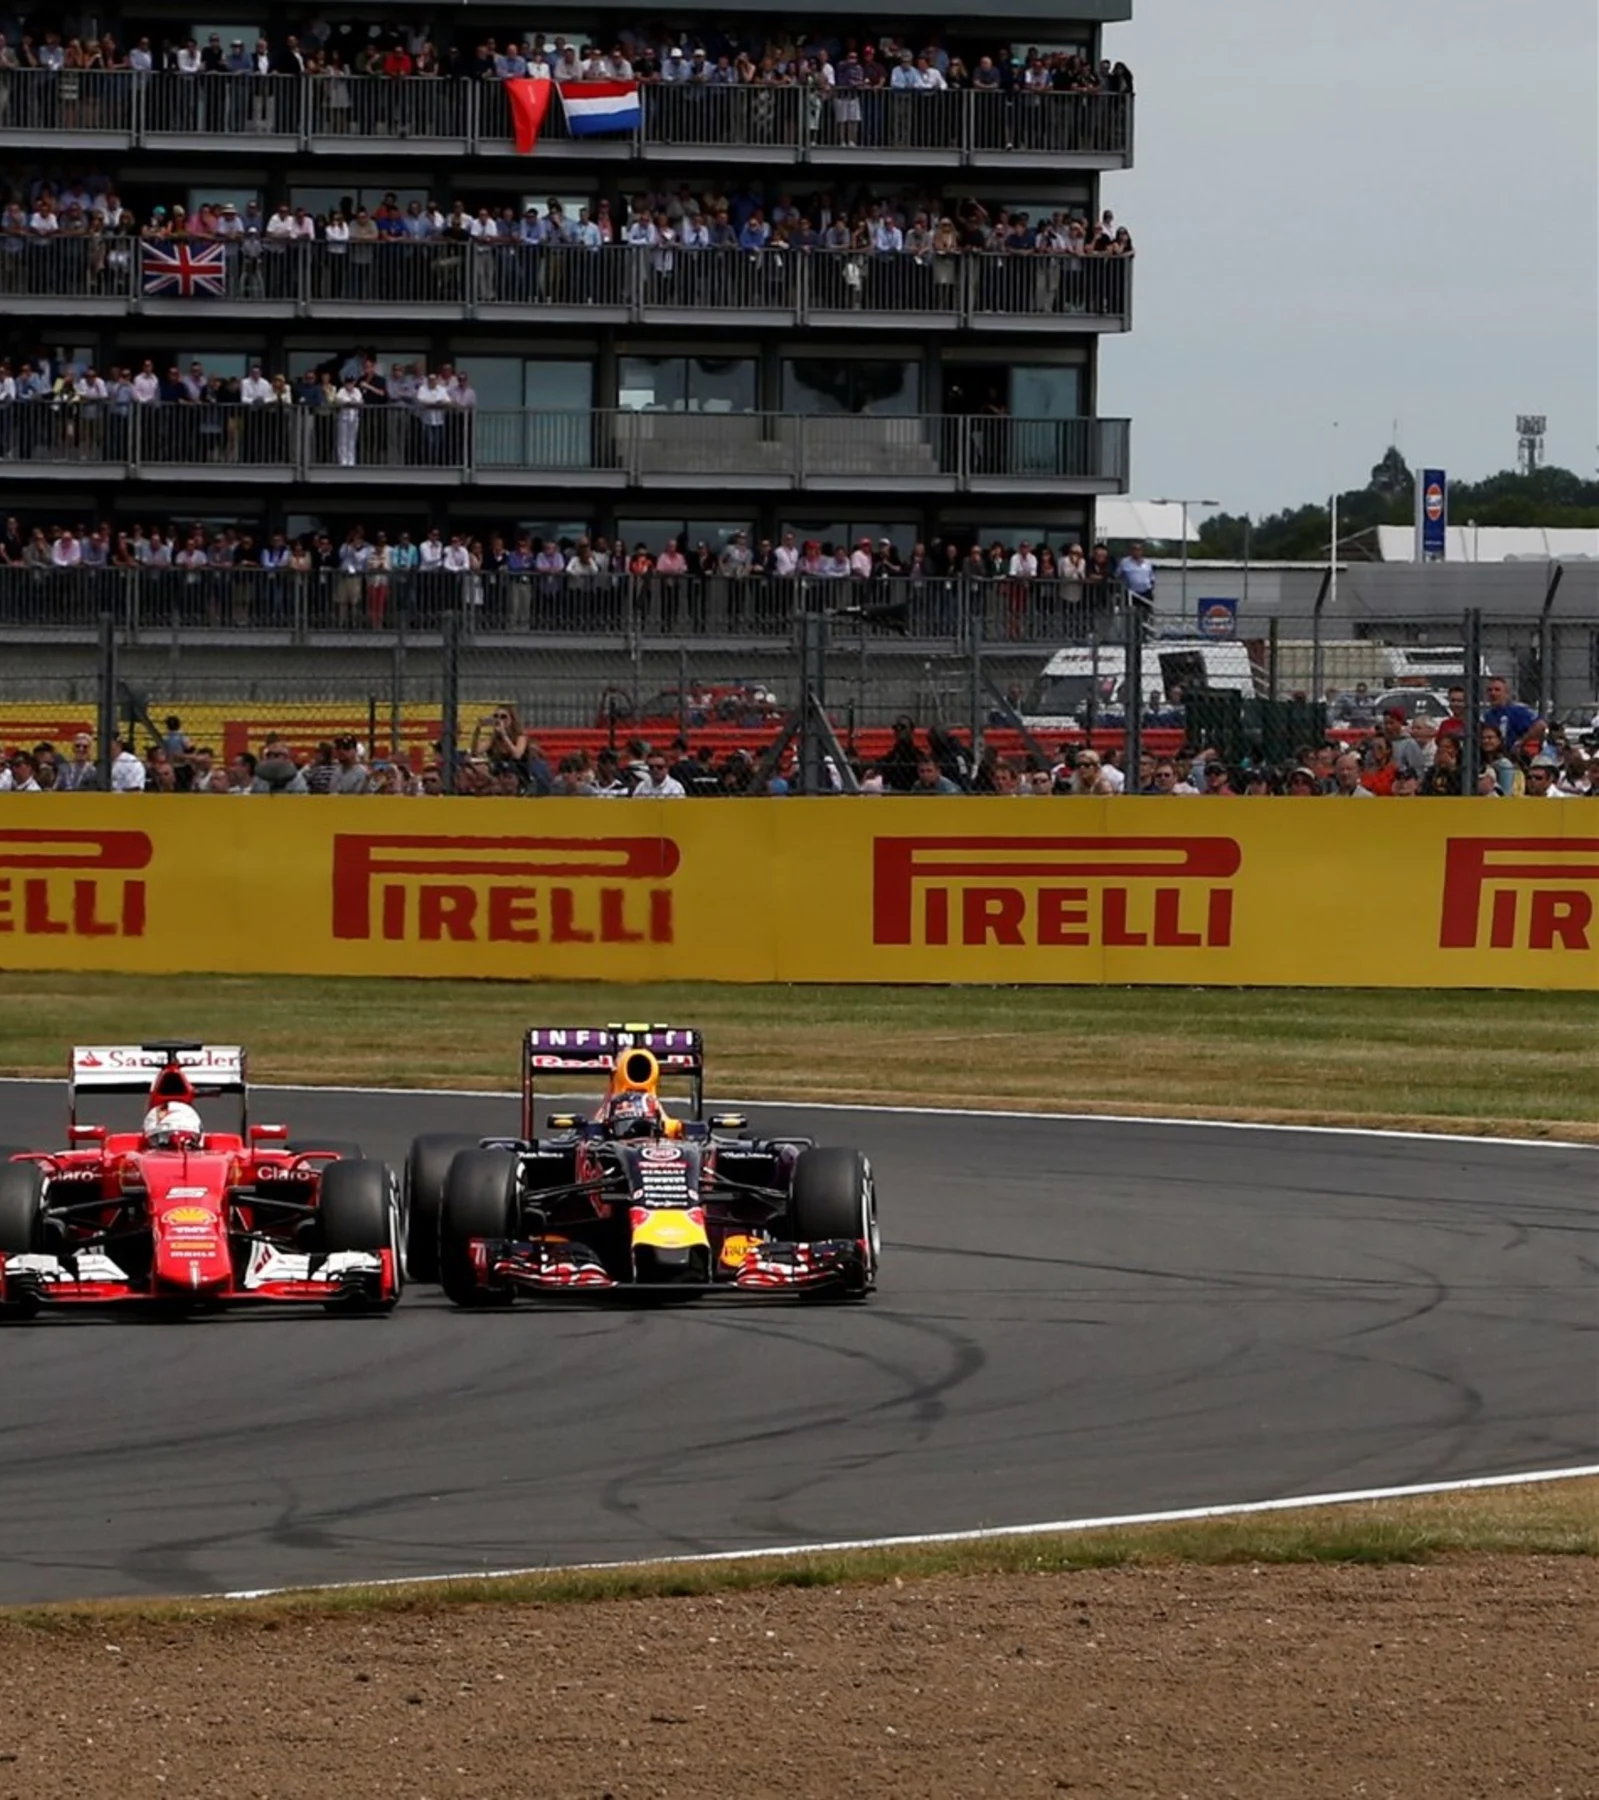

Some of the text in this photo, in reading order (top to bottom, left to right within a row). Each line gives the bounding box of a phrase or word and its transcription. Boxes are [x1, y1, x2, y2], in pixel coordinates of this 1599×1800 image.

[332, 834, 680, 943] PIRELLI
[873, 836, 1241, 946] PIRELLI
[1440, 837, 1599, 949] PIR
[109, 1051, 238, 1067] Sannder
[166, 1186, 208, 1199] 5
